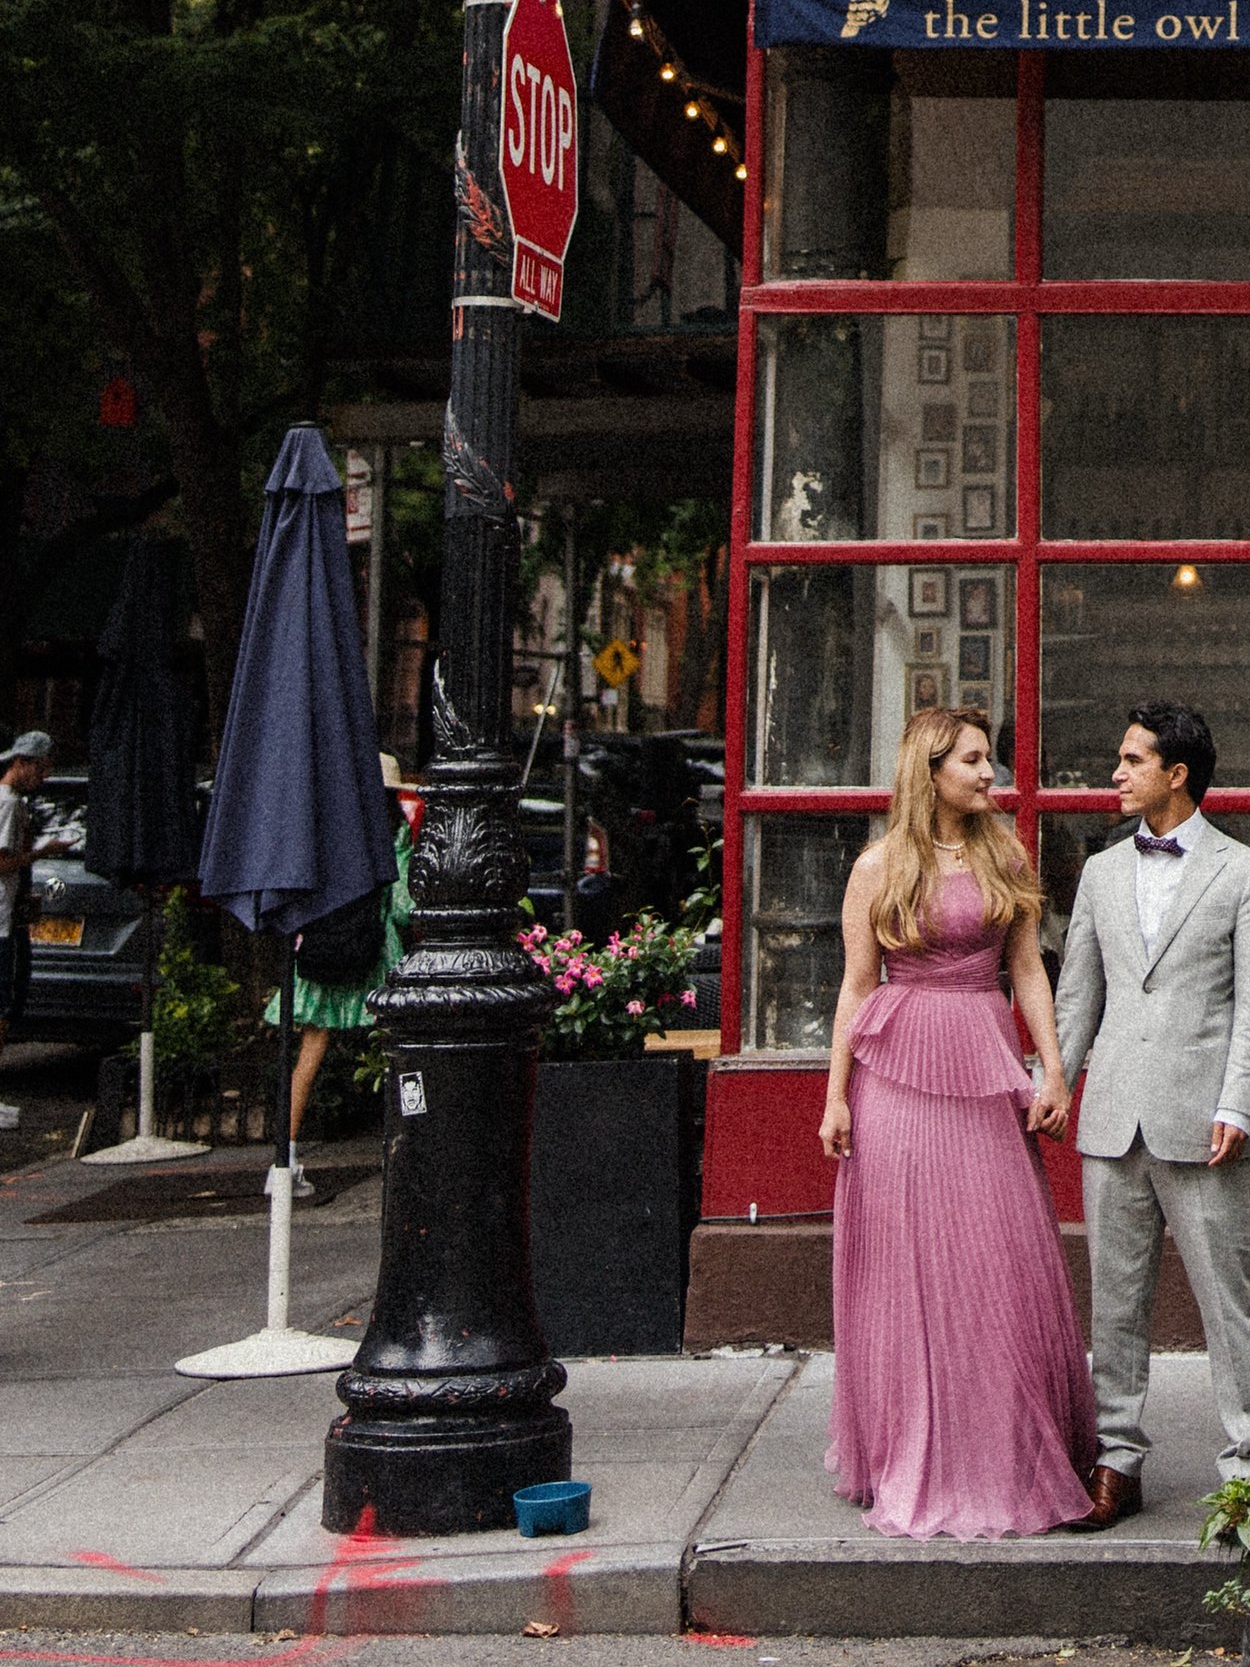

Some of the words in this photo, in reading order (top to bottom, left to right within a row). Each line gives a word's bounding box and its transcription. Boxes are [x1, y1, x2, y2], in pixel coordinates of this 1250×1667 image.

[1154, 0, 1241, 41] owl
[508, 53, 573, 192] STOP
[519, 254, 536, 295] ALL
[540, 264, 559, 305] WAY
